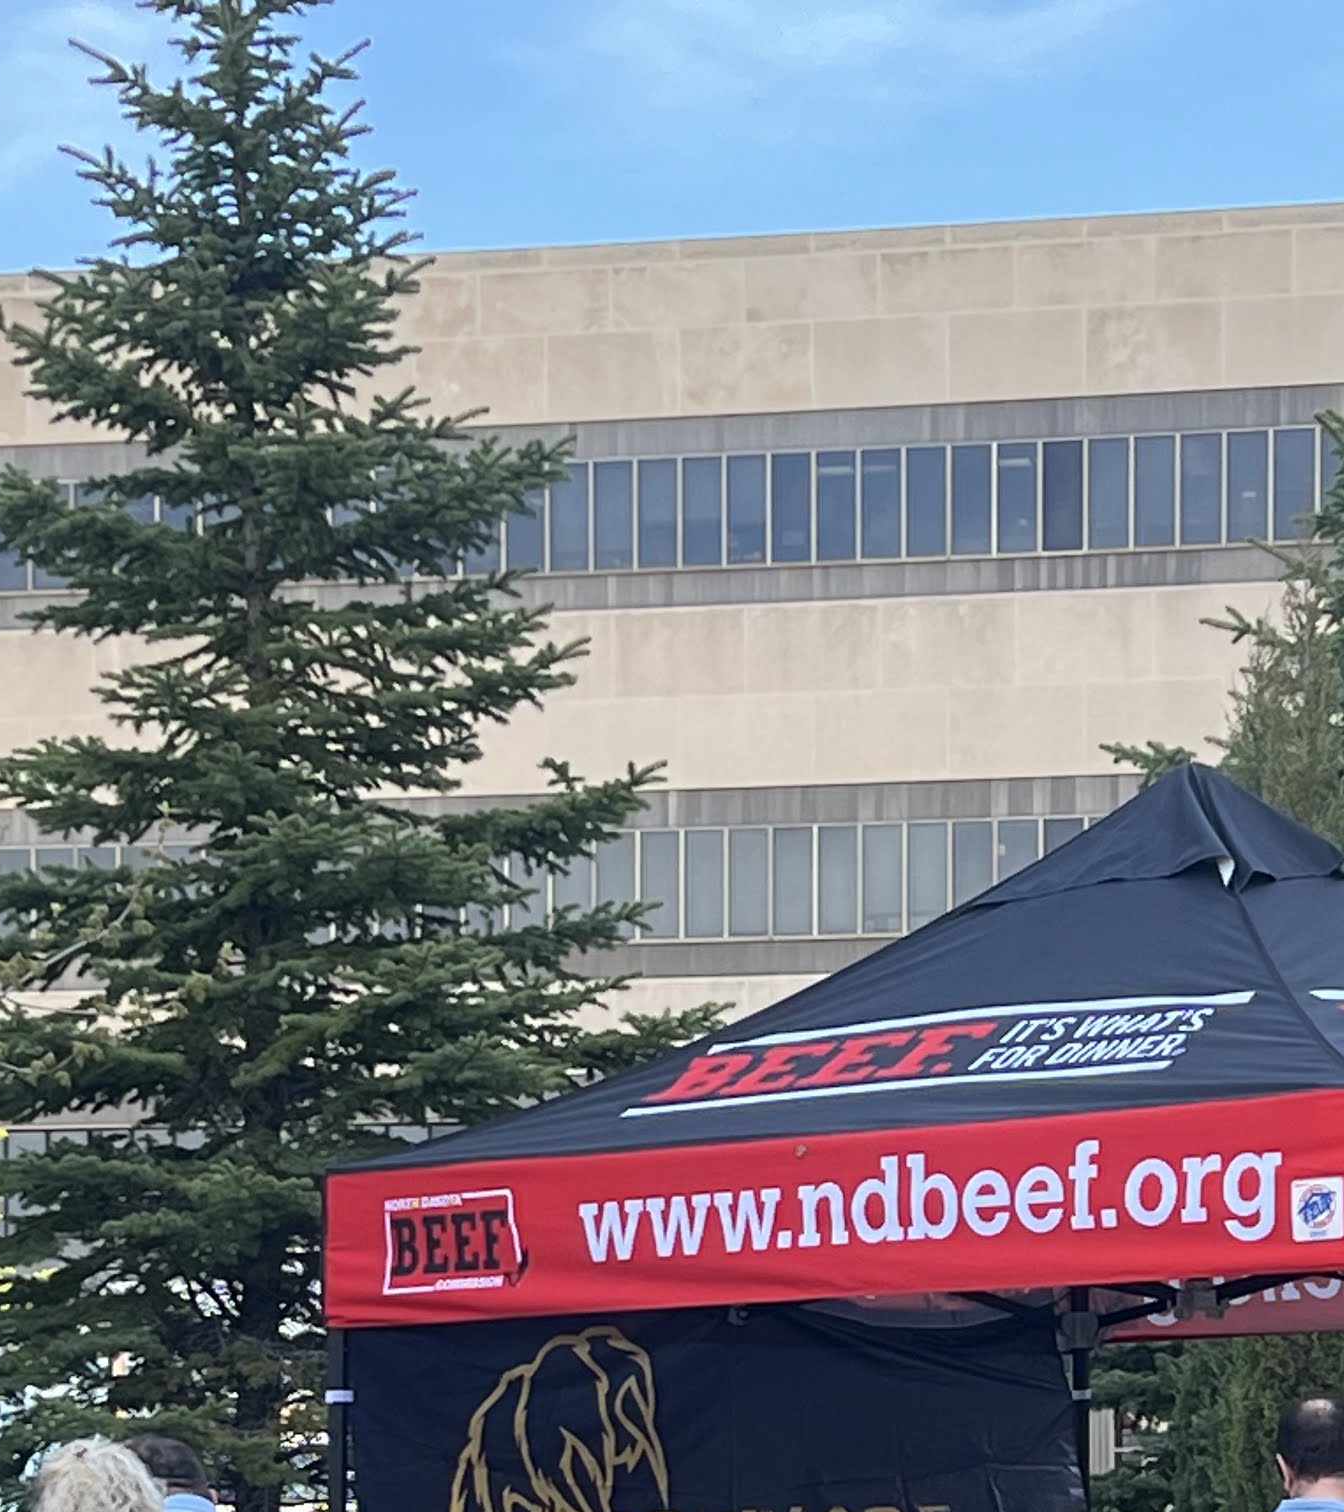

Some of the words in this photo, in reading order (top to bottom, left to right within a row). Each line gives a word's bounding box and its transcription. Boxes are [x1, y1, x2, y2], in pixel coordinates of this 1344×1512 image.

[967, 1044, 1050, 1071] FOR
[1043, 1032, 1188, 1065] DINNER.
[999, 1016, 1077, 1044] IT'S
[1073, 1007, 1215, 1039] WHAT'S
[641, 1021, 999, 1104] BEEF.
[578, 1139, 1282, 1263] www.ndbeef.org
[391, 1209, 508, 1277] BEEF
